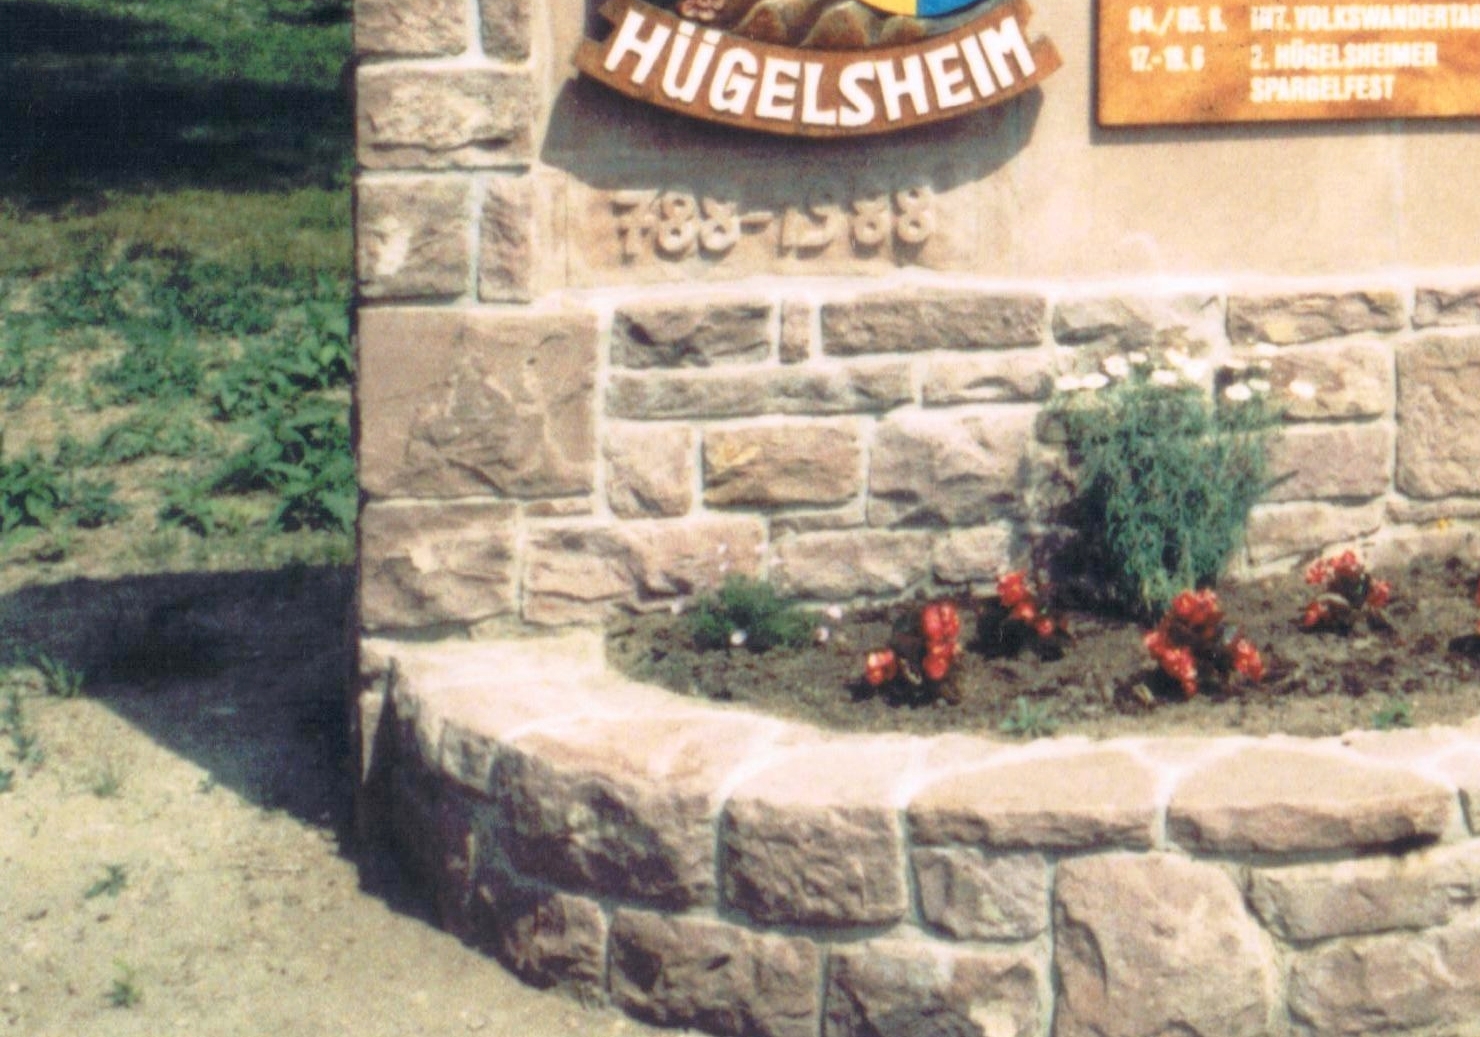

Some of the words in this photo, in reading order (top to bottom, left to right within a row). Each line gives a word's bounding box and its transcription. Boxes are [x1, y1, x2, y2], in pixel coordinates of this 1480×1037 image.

[1275, 39, 1437, 69] HÜGELSHEIMER
[602, 12, 1036, 127] HÜGELSHEIM
[1251, 75, 1395, 102] SPARGELFEST
